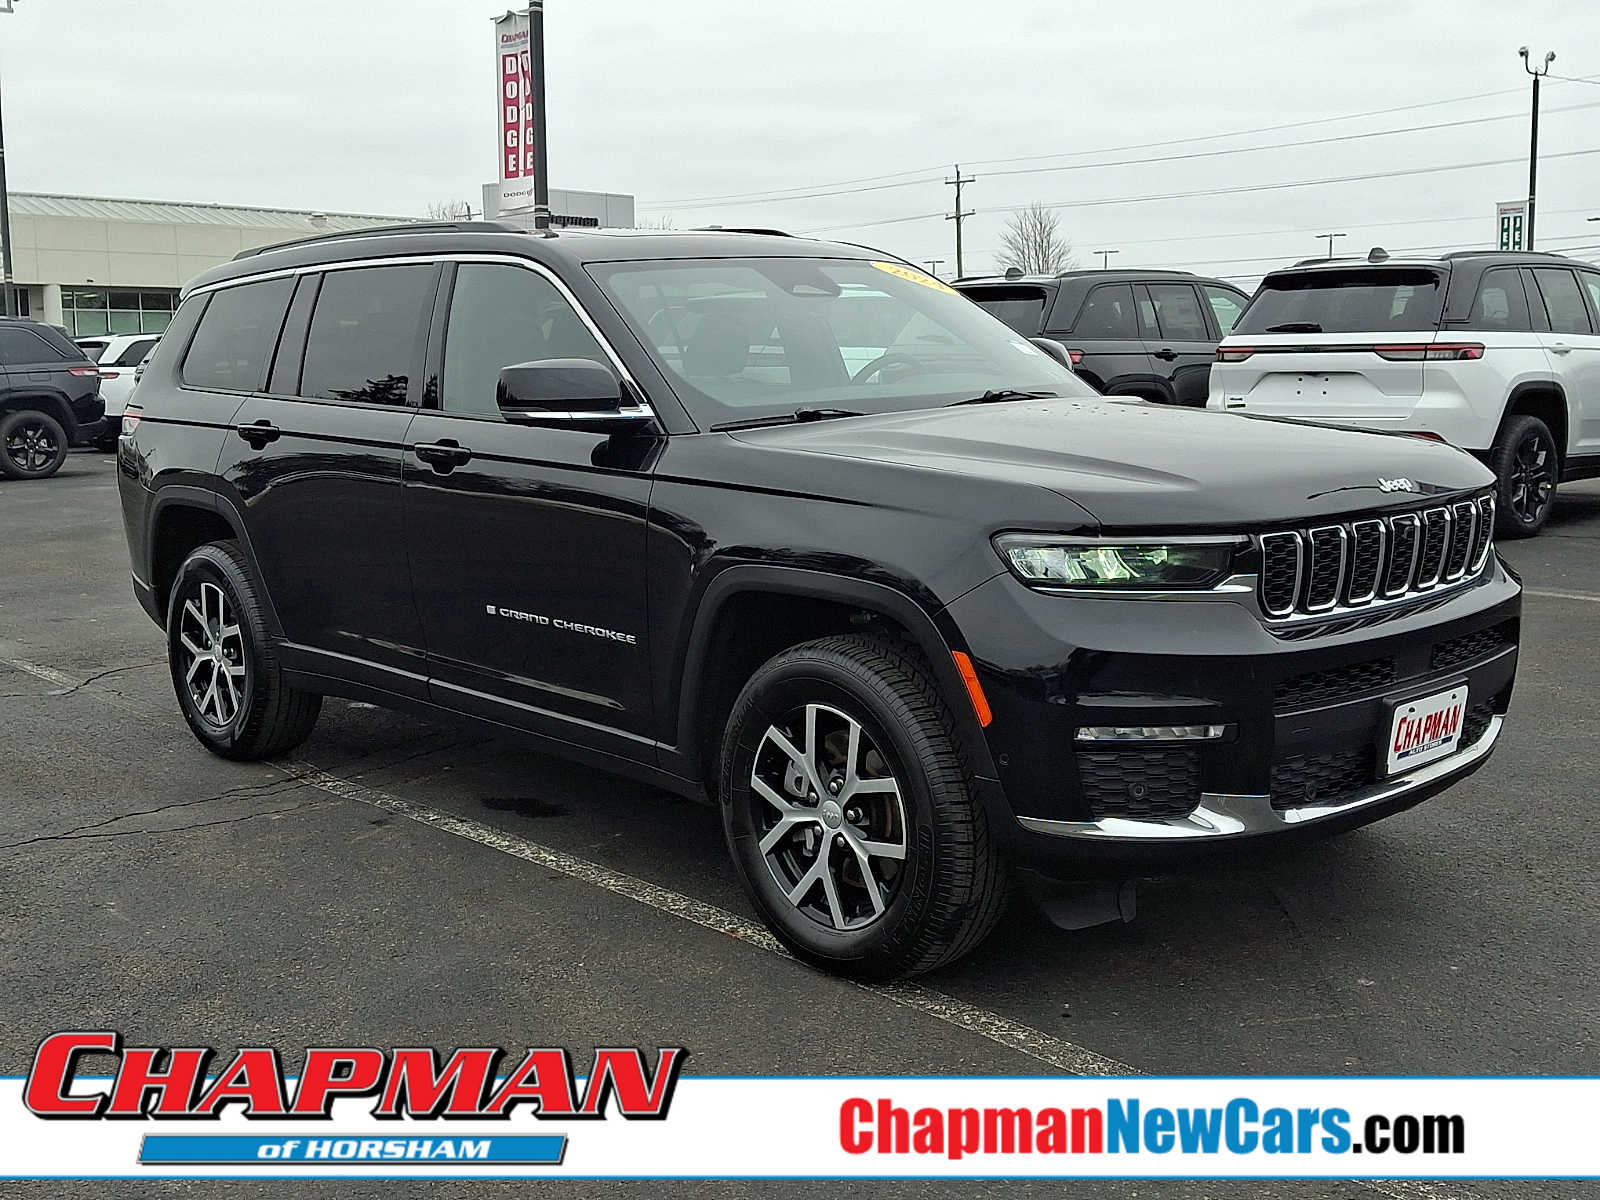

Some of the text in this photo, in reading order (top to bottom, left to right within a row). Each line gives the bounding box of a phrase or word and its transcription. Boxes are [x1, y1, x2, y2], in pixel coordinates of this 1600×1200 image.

[505, 56, 518, 172] DODGE
[1378, 477, 1413, 492] Jeep
[499, 607, 637, 645] GRAND CHEROKEE
[1393, 703, 1463, 753] CHAPMAN
